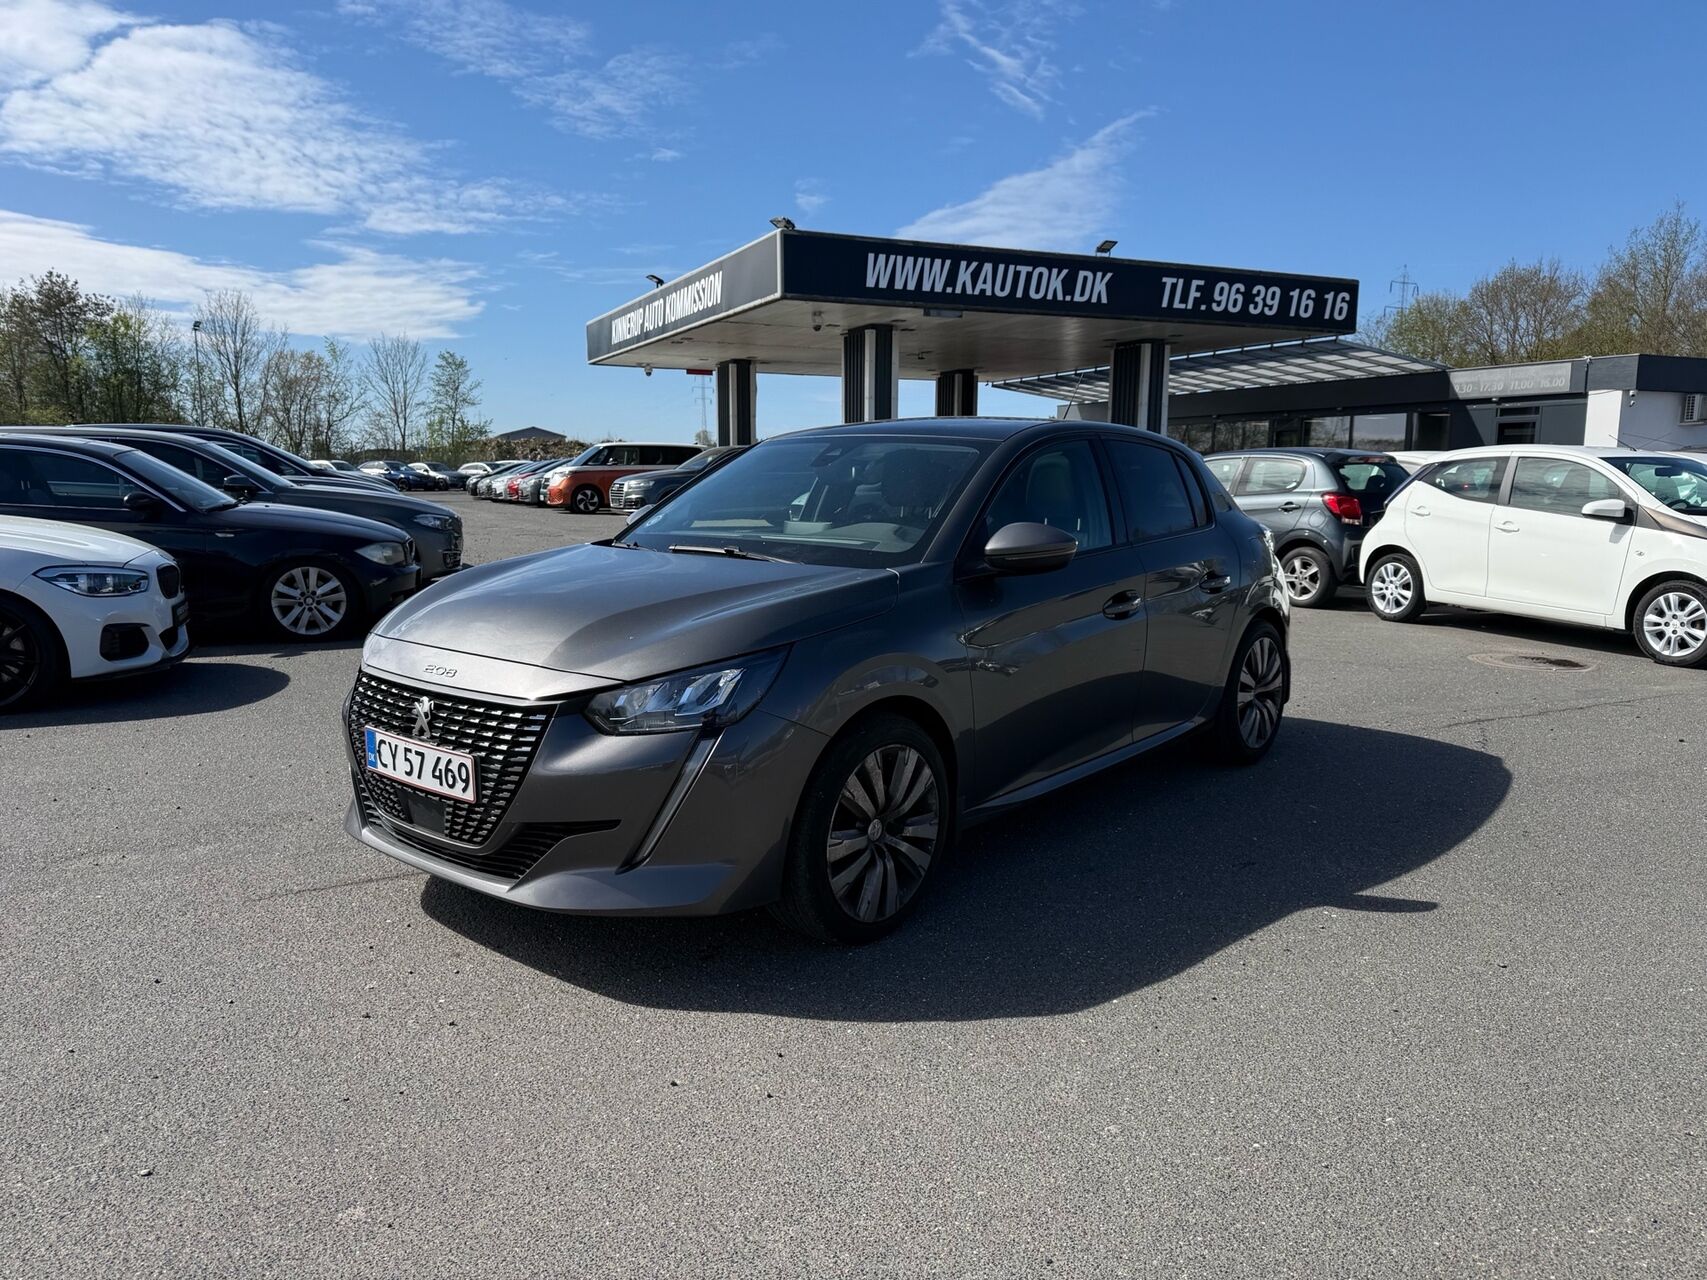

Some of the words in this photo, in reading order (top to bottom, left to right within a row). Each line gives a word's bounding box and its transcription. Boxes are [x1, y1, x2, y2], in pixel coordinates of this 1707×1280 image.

[865, 252, 1114, 305] WWW.KAUTOK.DK
[1161, 276, 1207, 311] TLF.
[1211, 281, 1244, 314] 96
[1248, 284, 1280, 317] 39
[1289, 287, 1316, 319] 16
[1323, 291, 1350, 321] 16
[611, 308, 643, 345] KINNERUP
[644, 298, 664, 332] AUTO
[665, 271, 723, 325] KOMMISSION
[423, 664, 458, 678] 208
[377, 738, 399, 772] CY
[403, 747, 426, 780] 57
[431, 756, 470, 794] 469
